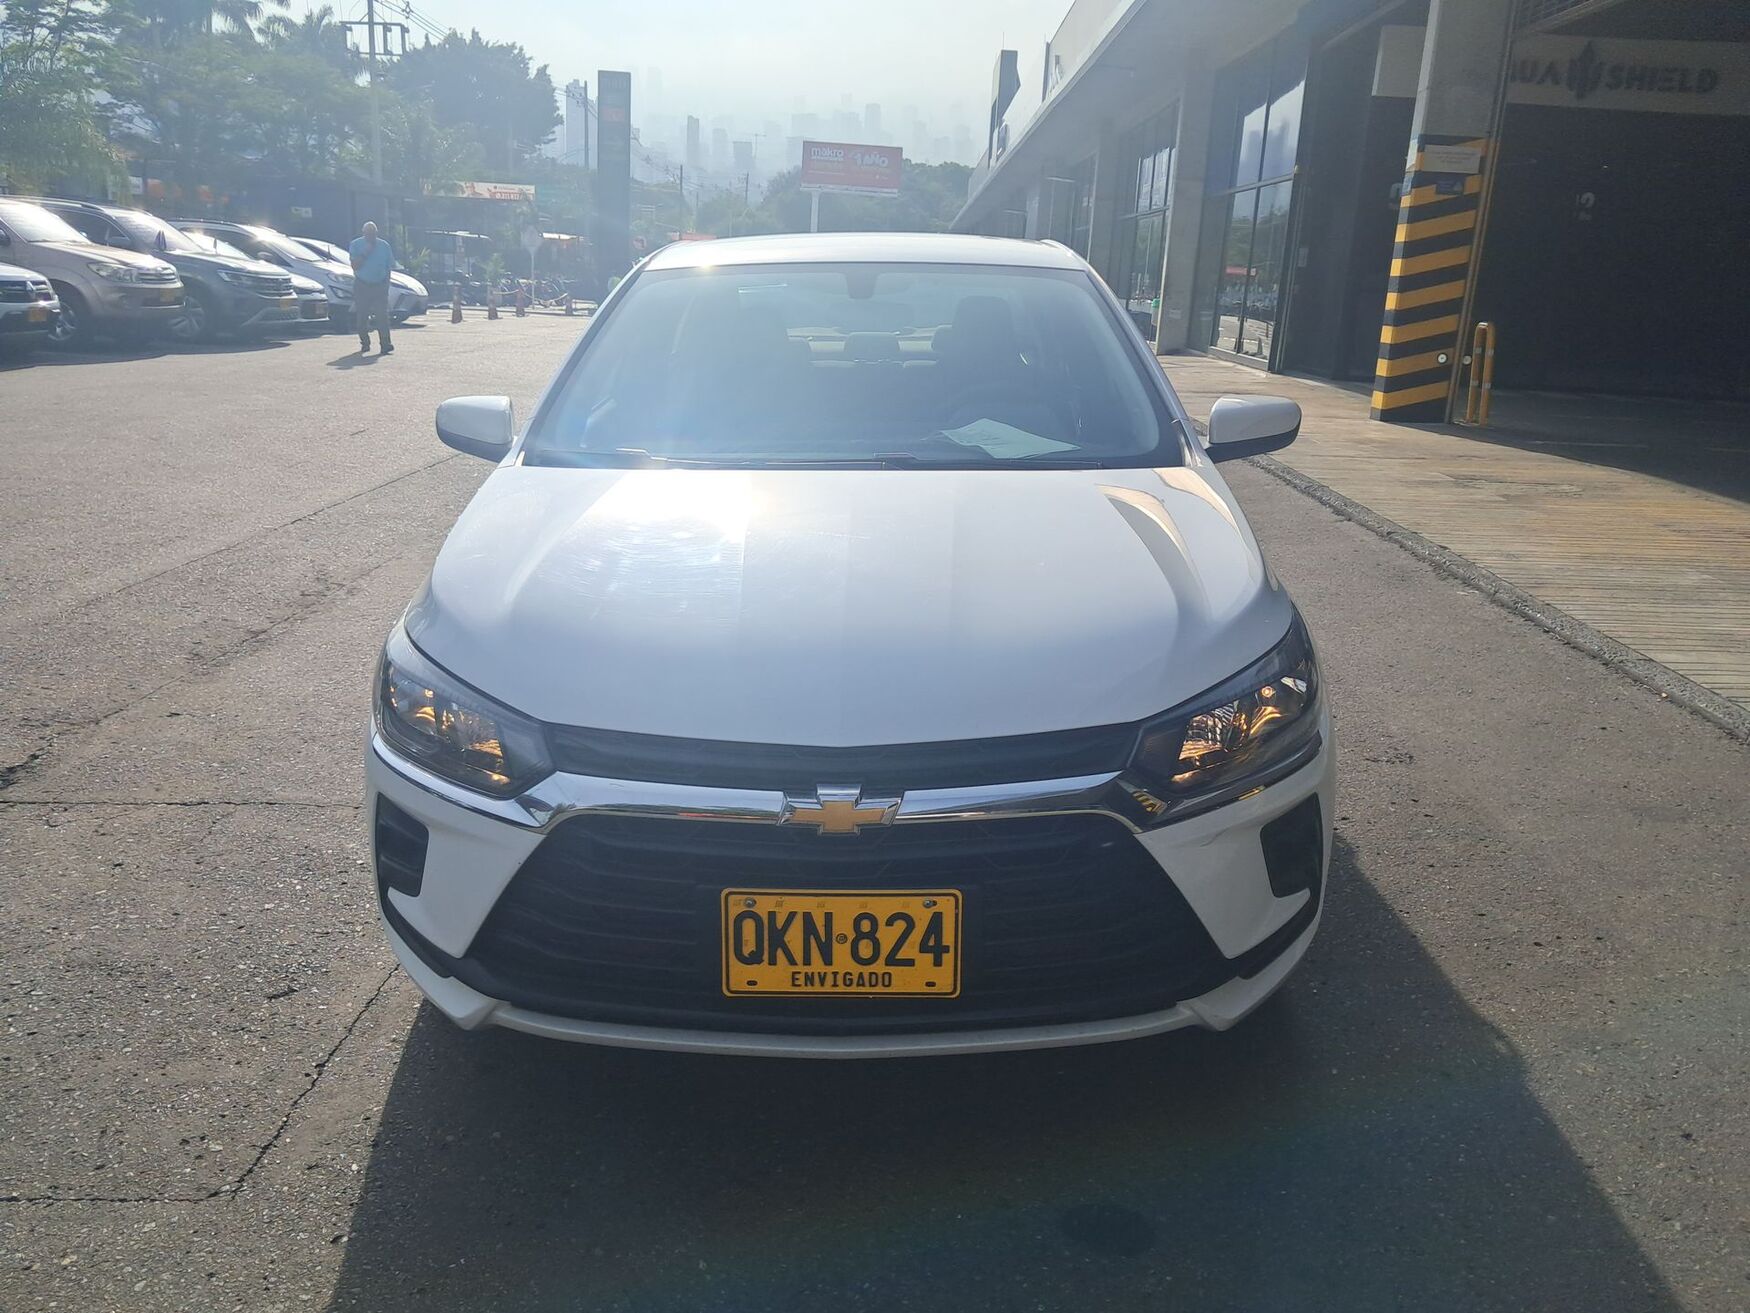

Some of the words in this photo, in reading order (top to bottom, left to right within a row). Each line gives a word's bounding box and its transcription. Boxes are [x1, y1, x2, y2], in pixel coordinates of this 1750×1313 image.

[1605, 62, 1719, 94] SHIELD
[811, 146, 844, 157] makro
[733, 909, 833, 966] QKN
[850, 911, 950, 967] 824
[791, 971, 893, 988] ENVIGADO
